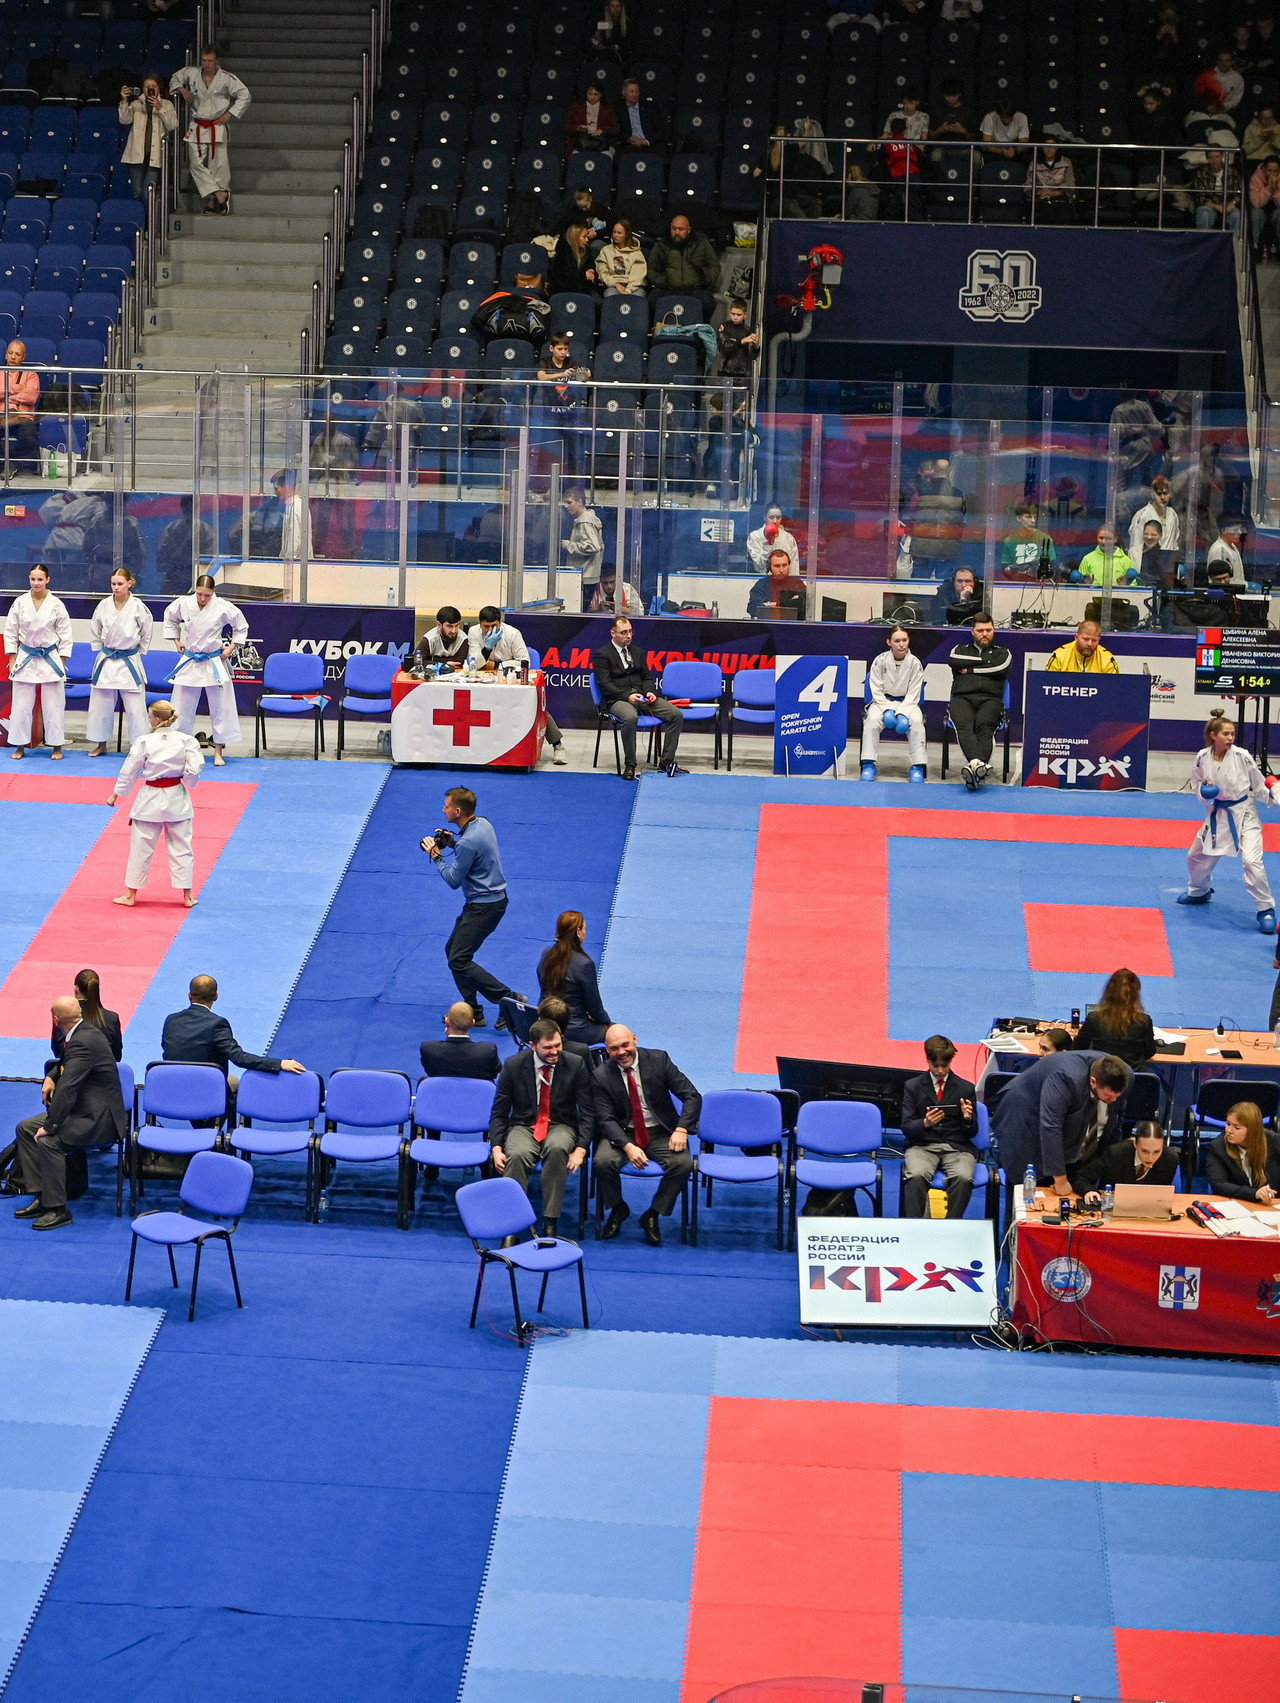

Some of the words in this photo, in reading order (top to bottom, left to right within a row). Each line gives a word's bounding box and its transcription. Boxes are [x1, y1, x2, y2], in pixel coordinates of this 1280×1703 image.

[174, 220, 181, 231] 6
[162, 268, 169, 279] 5
[1017, 290, 1037, 299] 2022
[964, 297, 982, 306] 1962
[149, 315, 157, 326] 4
[289, 639, 384, 661] КУБОК
[1239, 675, 1271, 688] 1:54.0
[797, 665, 838, 712] 4
[1042, 685, 1098, 697] ТРЕНЕР
[780, 716, 823, 729] POKRYSHKIN
[781, 713, 800, 721] OPEN
[780, 726, 807, 736] KARATE
[807, 724, 822, 732] CUP
[1040, 737, 1089, 745] ФЕДЕРАЦИЯ
[807, 1235, 900, 1244] ФЕДЕРАЦИЯ
[807, 1244, 865, 1252] КАРАТЭ
[807, 1253, 866, 1261] РОССИИ
